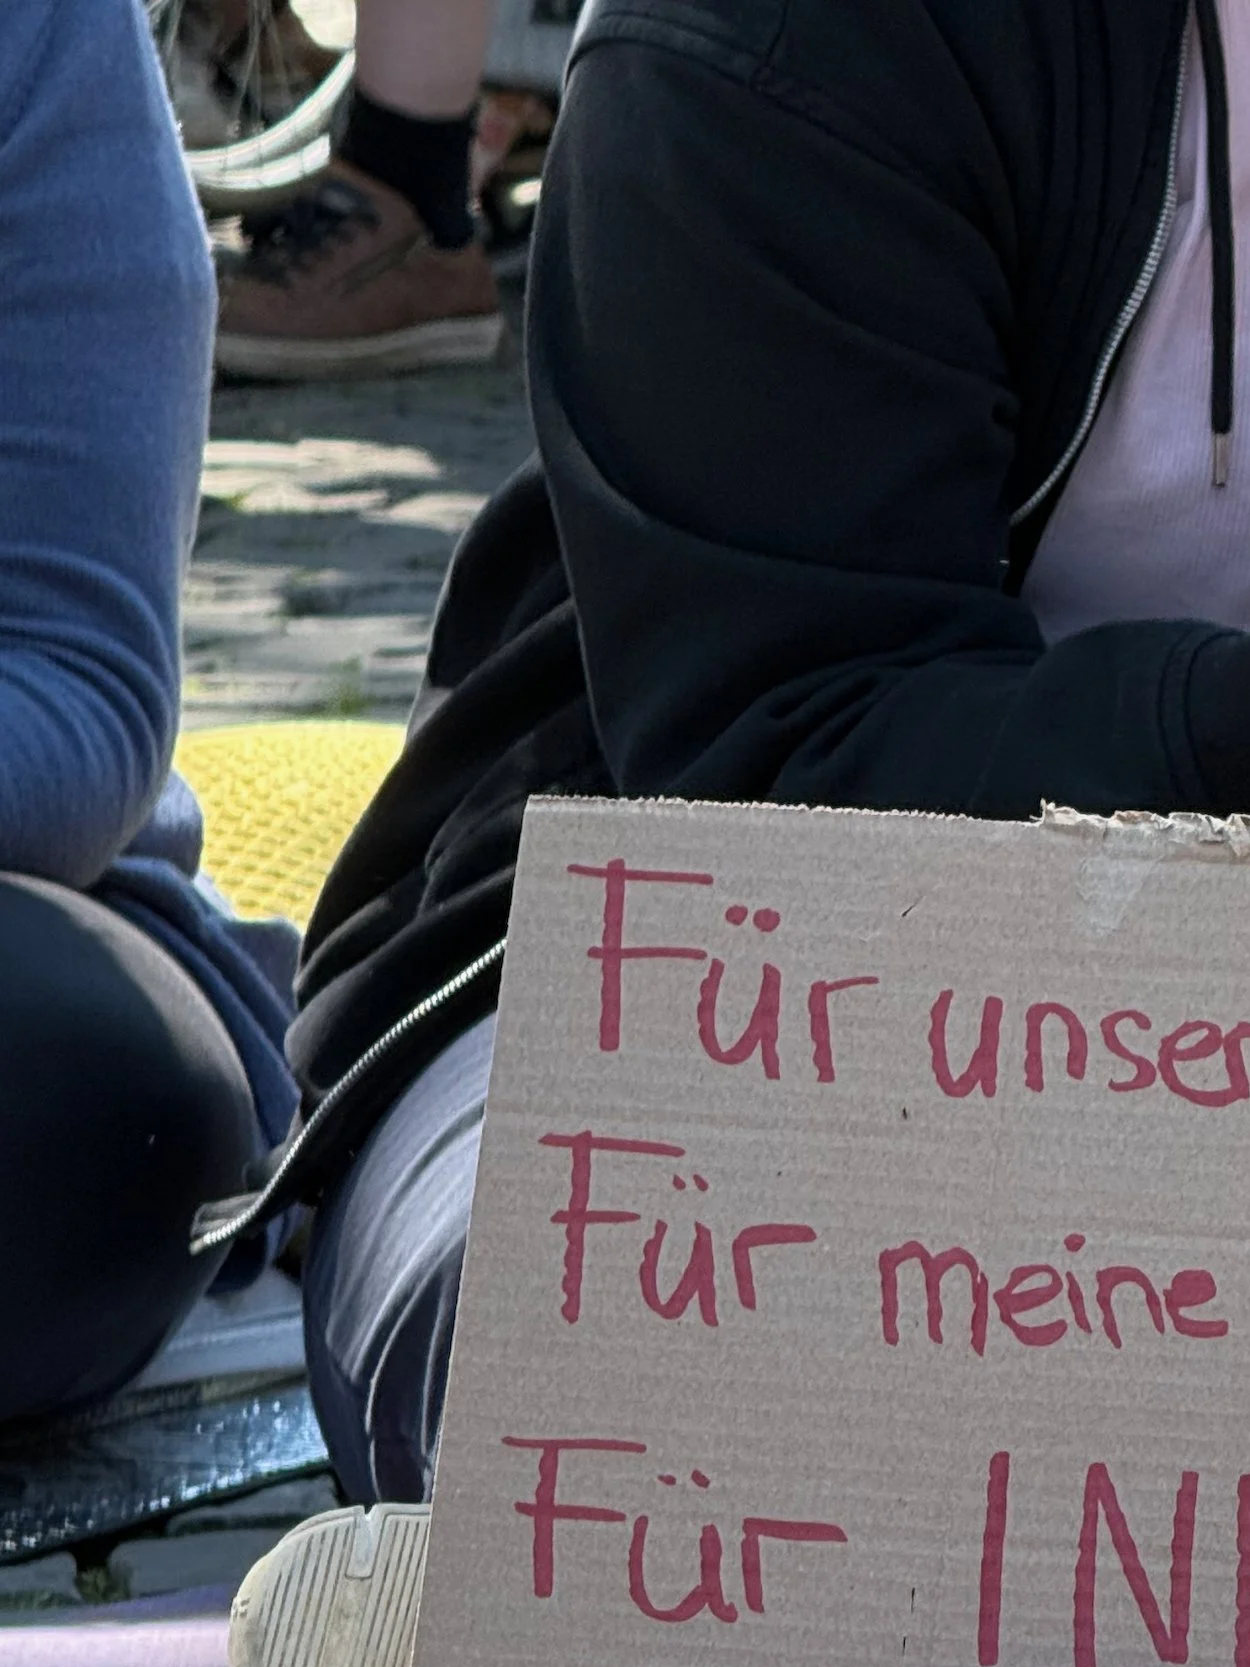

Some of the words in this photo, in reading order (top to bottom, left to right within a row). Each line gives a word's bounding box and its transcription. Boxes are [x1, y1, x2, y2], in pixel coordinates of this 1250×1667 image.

[567, 858, 880, 1083] Für
[538, 1130, 816, 1325] Für
[877, 1234, 1229, 1356] meine
[501, 1435, 848, 1624] Für
